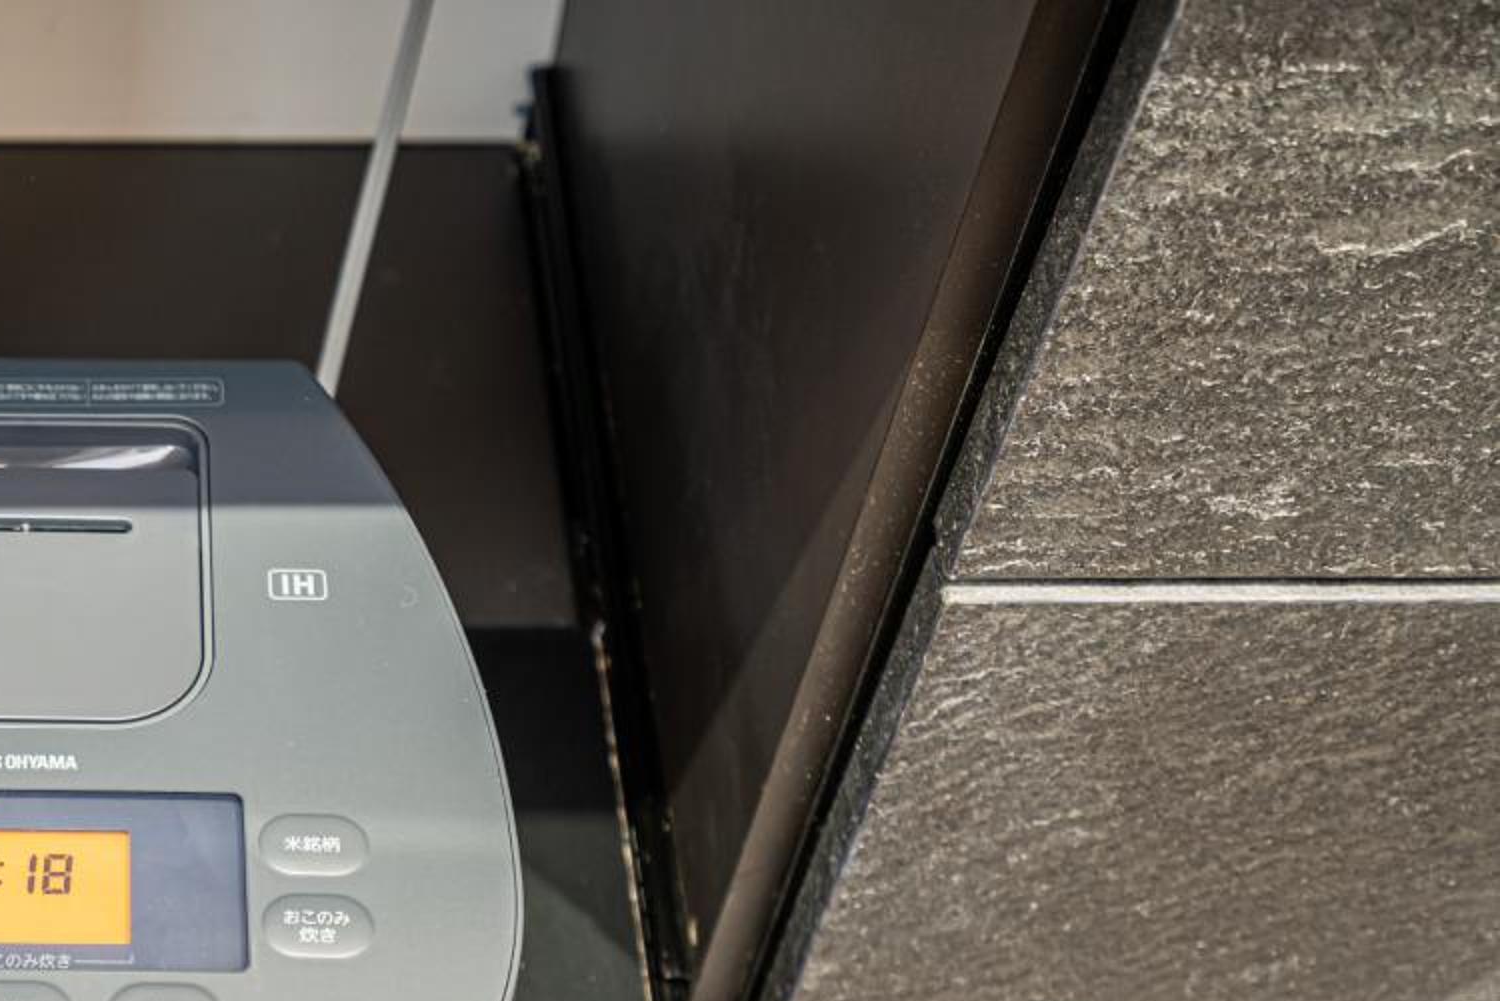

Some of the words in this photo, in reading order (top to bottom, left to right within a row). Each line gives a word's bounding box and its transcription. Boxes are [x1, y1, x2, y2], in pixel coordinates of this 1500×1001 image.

[281, 573, 315, 596] IH
[5, 754, 78, 770] OHYAMA
[283, 835, 341, 853] 米銘柄
[283, 909, 350, 927] おこのみ
[299, 927, 338, 945] 炊き
